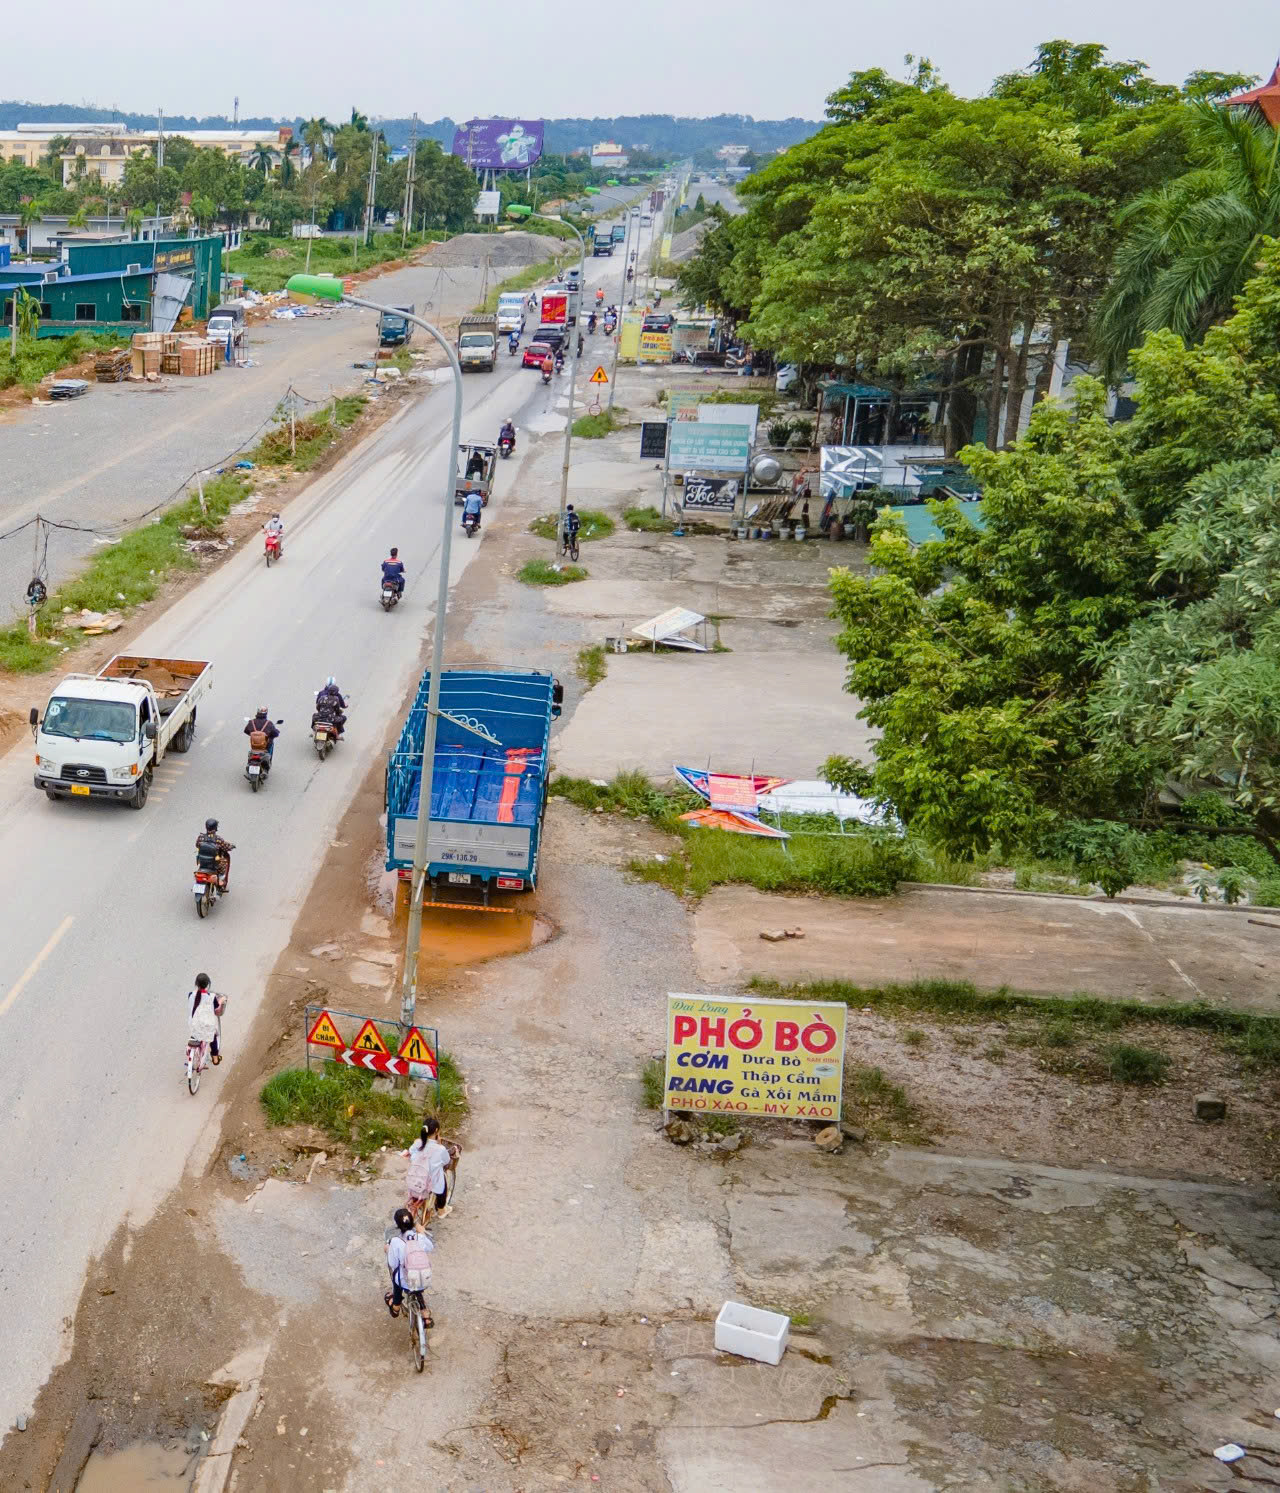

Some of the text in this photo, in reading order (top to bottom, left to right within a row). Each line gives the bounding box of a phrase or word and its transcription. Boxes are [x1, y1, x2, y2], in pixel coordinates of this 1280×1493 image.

[673, 1008, 837, 1054] PHỞ BÒ
[677, 1050, 729, 1070] CƠM
[742, 1053, 801, 1067] Dưa Bò
[668, 1076, 734, 1095] RANG
[740, 1070, 821, 1085] Thập Cẩm
[740, 1086, 760, 1098] Gà
[671, 1095, 707, 1109] PHỞ
[712, 1097, 748, 1111] XÀO
[797, 1103, 833, 1117] XÀO
